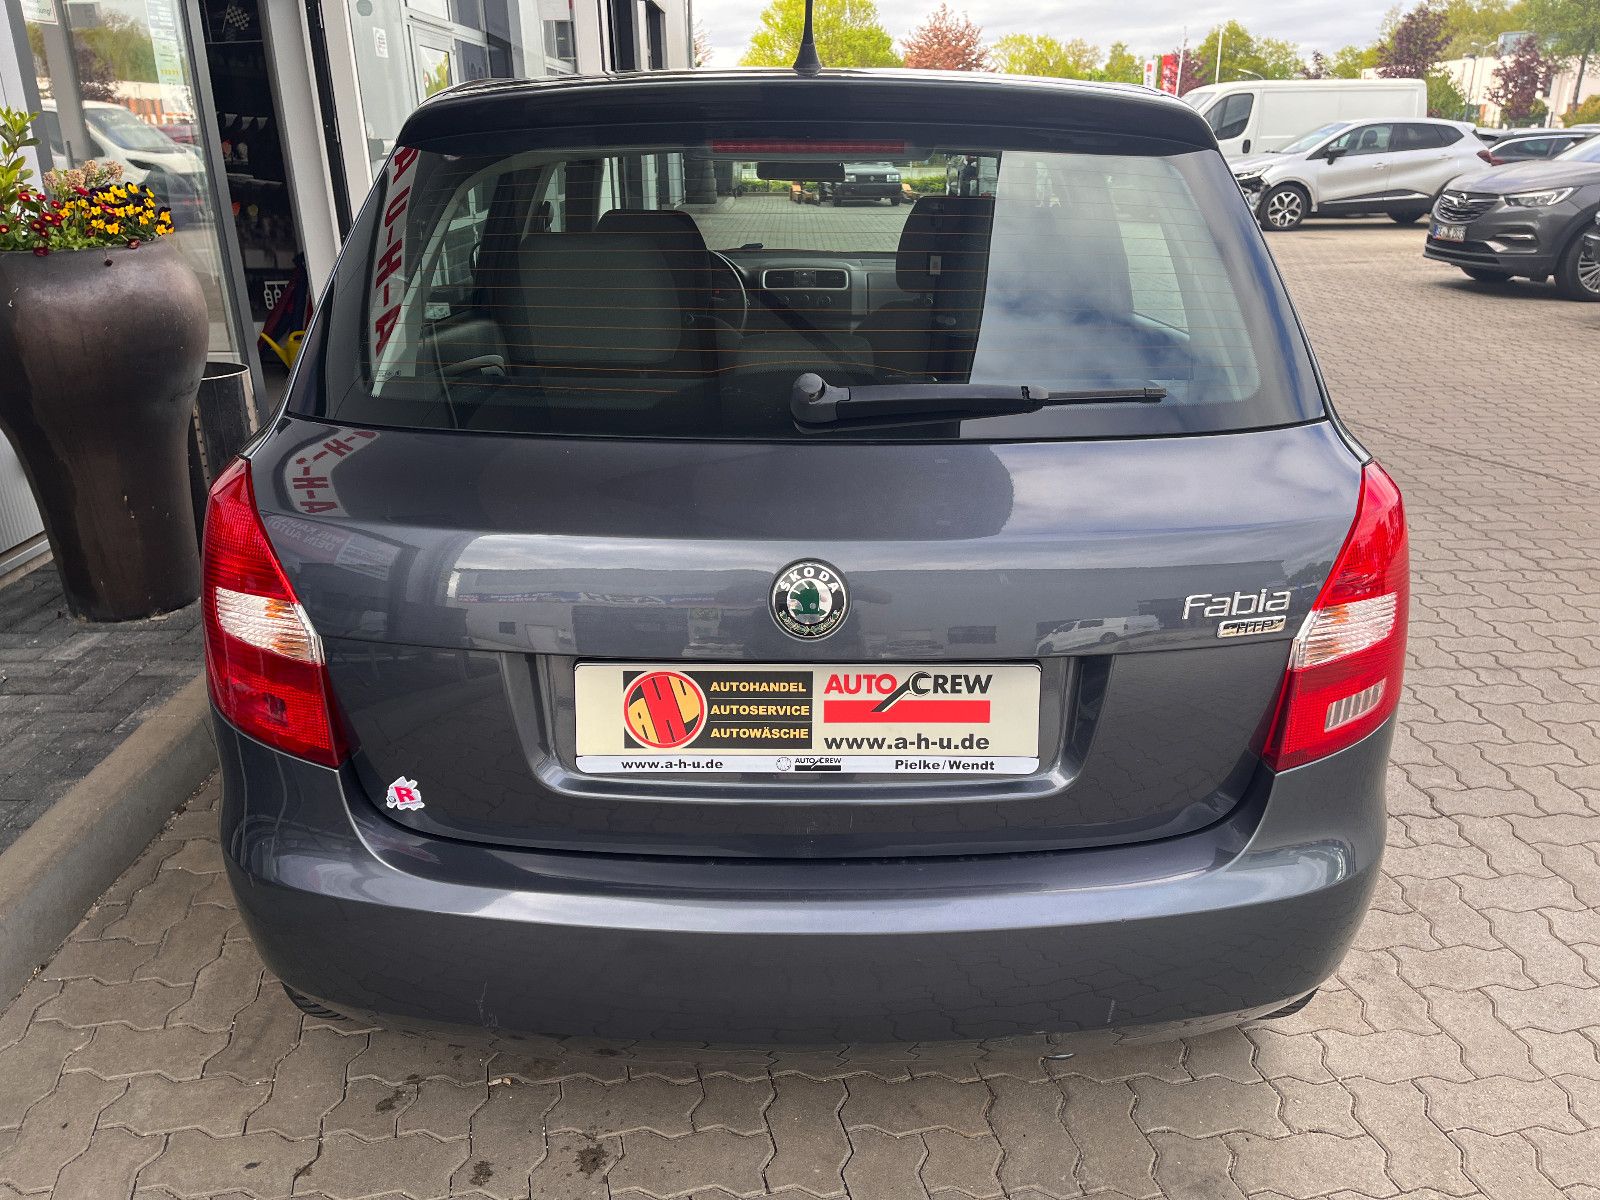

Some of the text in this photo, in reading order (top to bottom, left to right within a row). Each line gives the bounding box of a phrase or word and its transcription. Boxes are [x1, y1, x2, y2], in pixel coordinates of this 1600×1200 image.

[1182, 589, 1292, 620] Fabia
[710, 682, 806, 692] AUTOHANDEL
[824, 672, 993, 696] AUTO CREW
[710, 705, 810, 716] AUTOSERVICE
[710, 726, 809, 739] AUTOWÄSCHE
[824, 733, 990, 750] www.a-h-u.de
[621, 759, 724, 769] www.a-h-u.de
[394, 786, 415, 803] R
